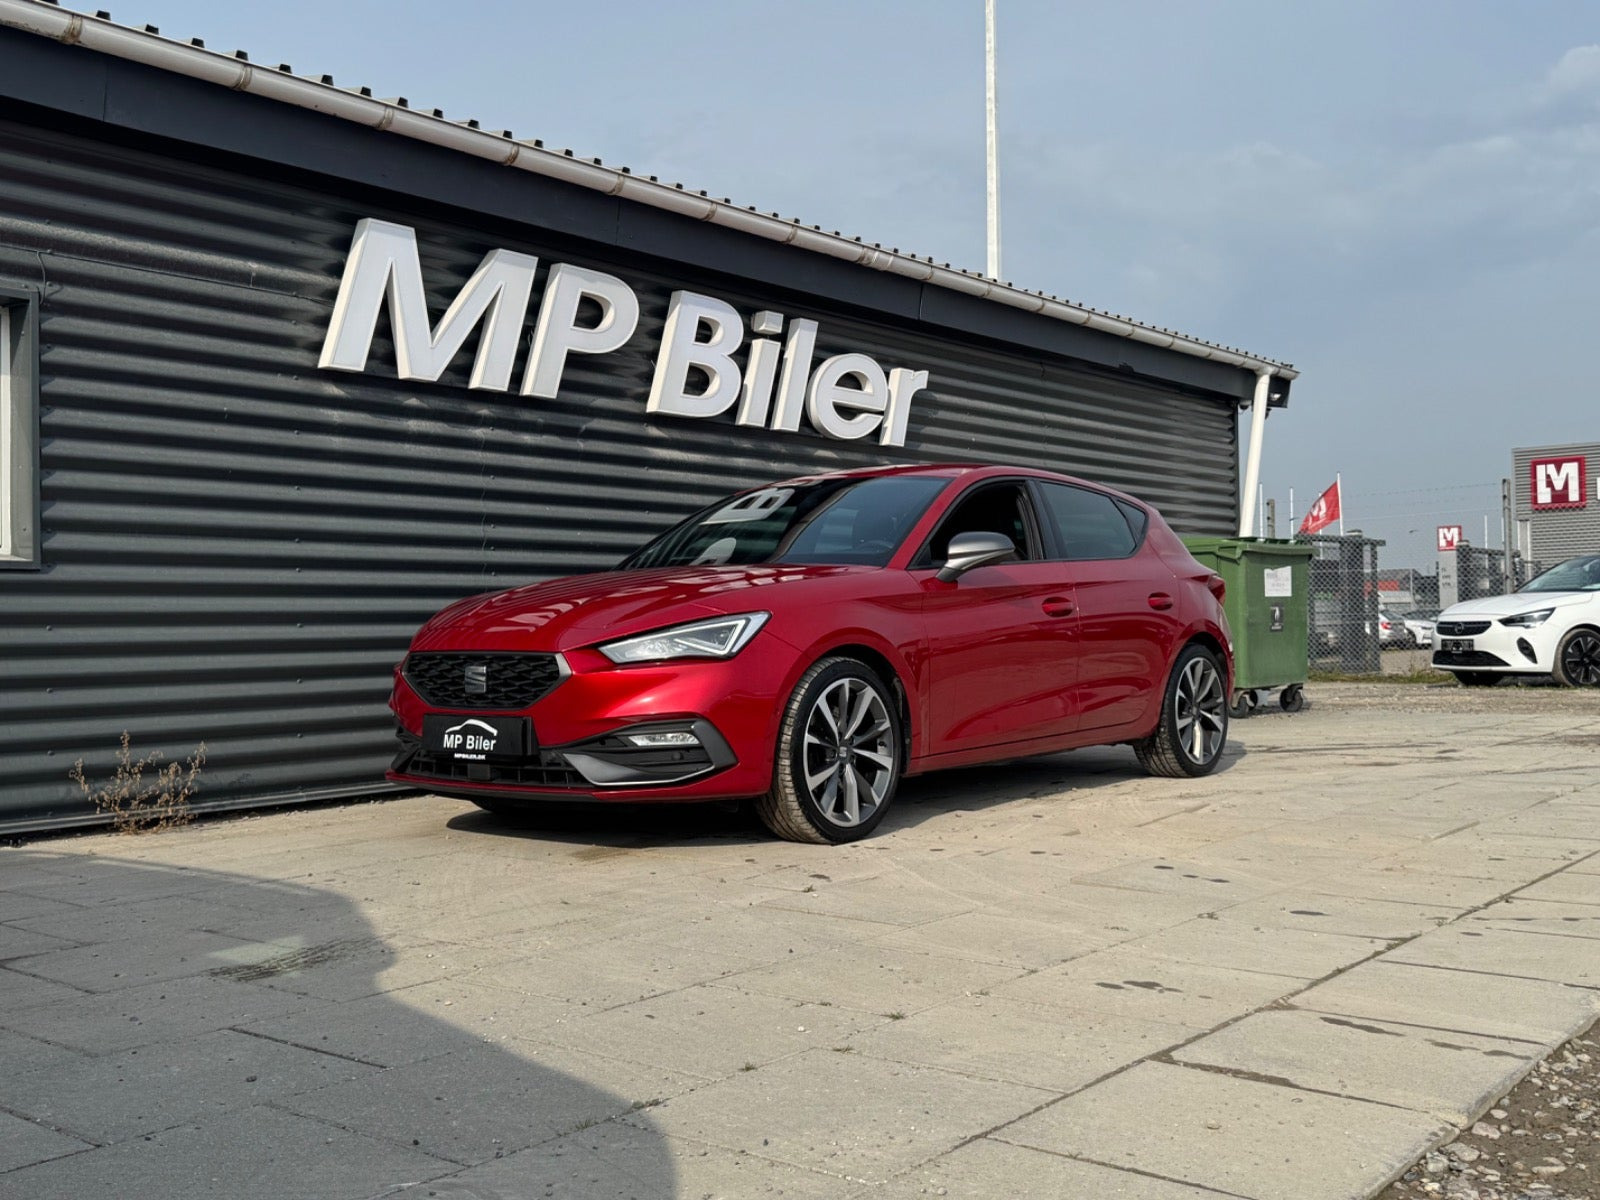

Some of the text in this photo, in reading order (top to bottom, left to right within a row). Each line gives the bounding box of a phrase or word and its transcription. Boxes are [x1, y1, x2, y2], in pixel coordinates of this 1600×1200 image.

[318, 218, 928, 447] MP Biler
[443, 734, 497, 751] MP Biler
